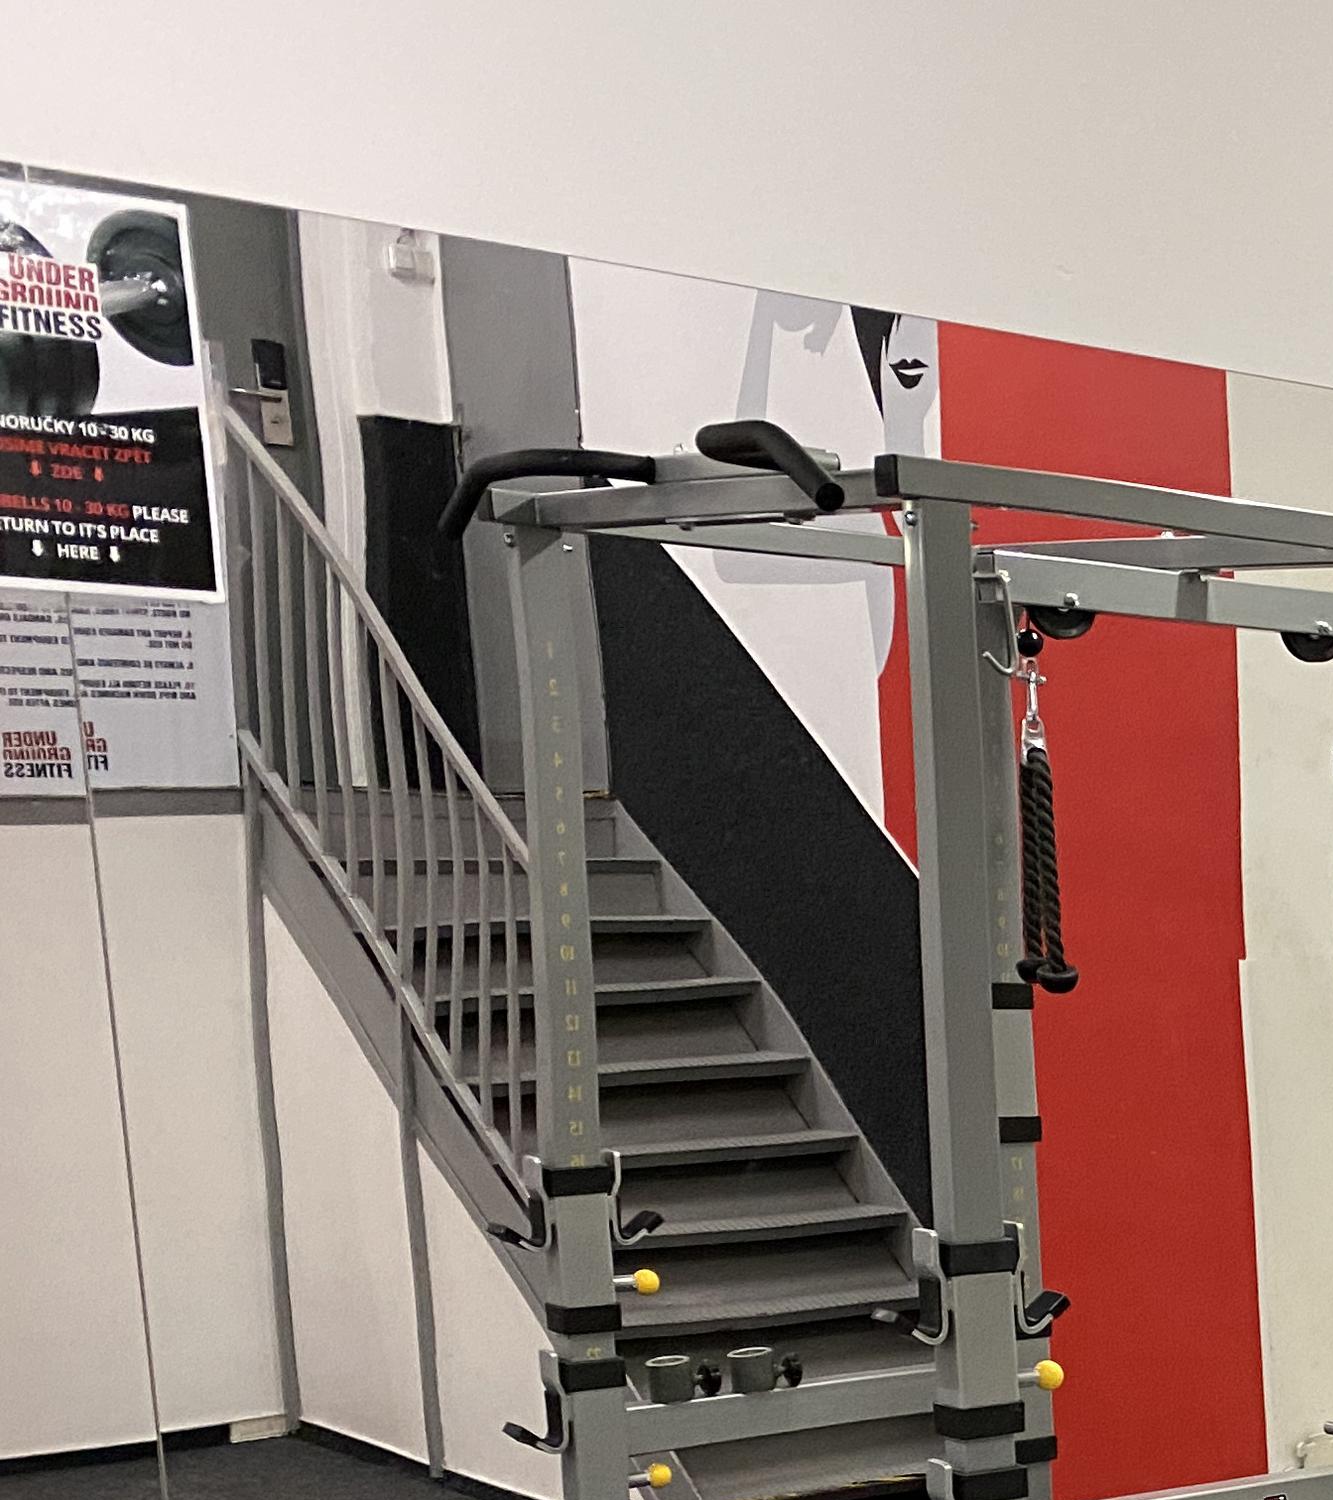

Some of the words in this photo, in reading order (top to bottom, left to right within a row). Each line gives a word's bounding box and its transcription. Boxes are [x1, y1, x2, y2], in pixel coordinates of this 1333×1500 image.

[9, 253, 95, 293] UNDER
[0, 279, 99, 312] GROUND
[0, 305, 102, 340] FITNESS
[131, 429, 155, 443] KG
[132, 505, 189, 523] PLEASE
[52, 521, 75, 536] TO
[110, 525, 160, 543] PLACE
[57, 543, 100, 561] HERE
